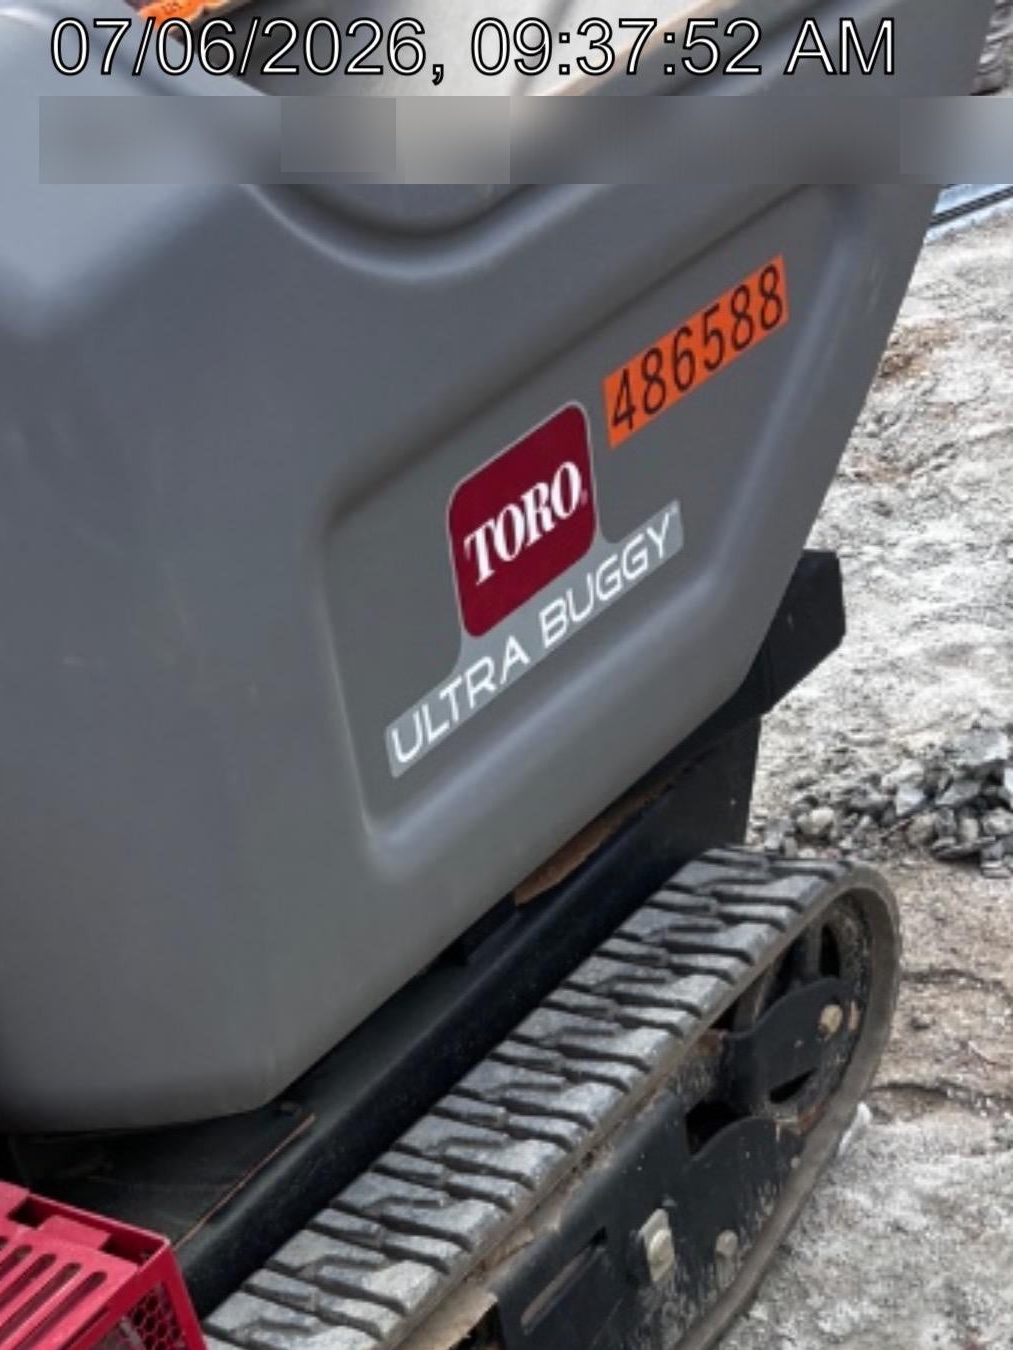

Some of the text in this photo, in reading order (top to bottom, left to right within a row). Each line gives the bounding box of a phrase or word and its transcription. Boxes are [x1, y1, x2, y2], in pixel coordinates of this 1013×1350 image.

[610, 263, 785, 433] 486588
[463, 460, 583, 584] TORO
[390, 511, 671, 764] ULTRA BUGGY
